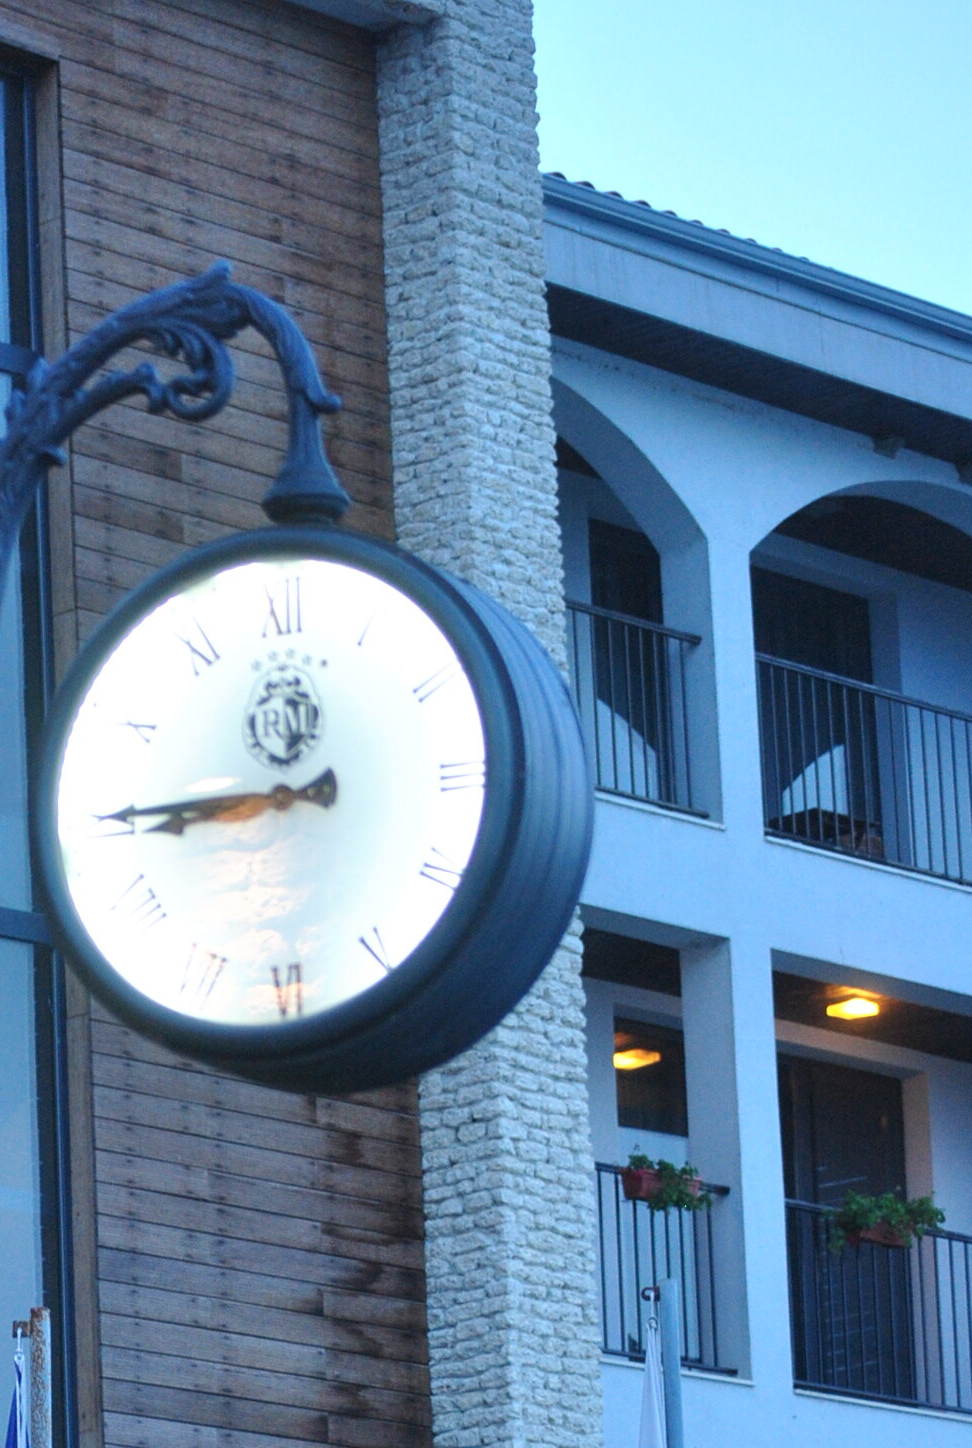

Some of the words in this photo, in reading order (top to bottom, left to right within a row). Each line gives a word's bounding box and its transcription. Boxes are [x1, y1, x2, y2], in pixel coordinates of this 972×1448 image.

[262, 576, 303, 638] XII
[174, 616, 221, 677] XI
[439, 760, 485, 792] III
[271, 962, 303, 1017] VI
